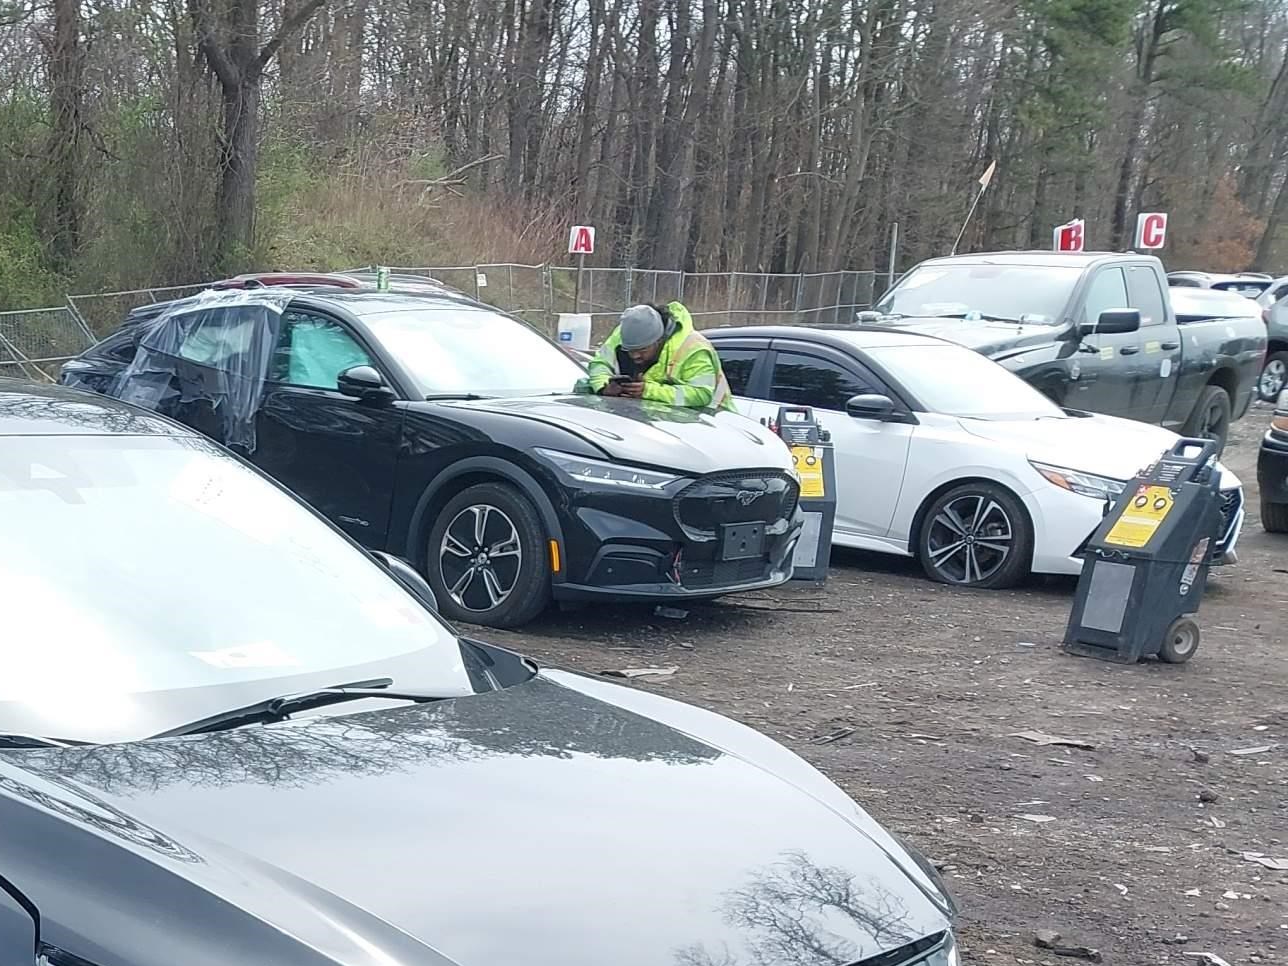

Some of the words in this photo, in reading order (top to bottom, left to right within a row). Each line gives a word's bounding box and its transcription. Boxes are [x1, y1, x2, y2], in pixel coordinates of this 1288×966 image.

[573, 228, 592, 252] A
[1060, 223, 1082, 251] B
[1143, 214, 1164, 247] C
